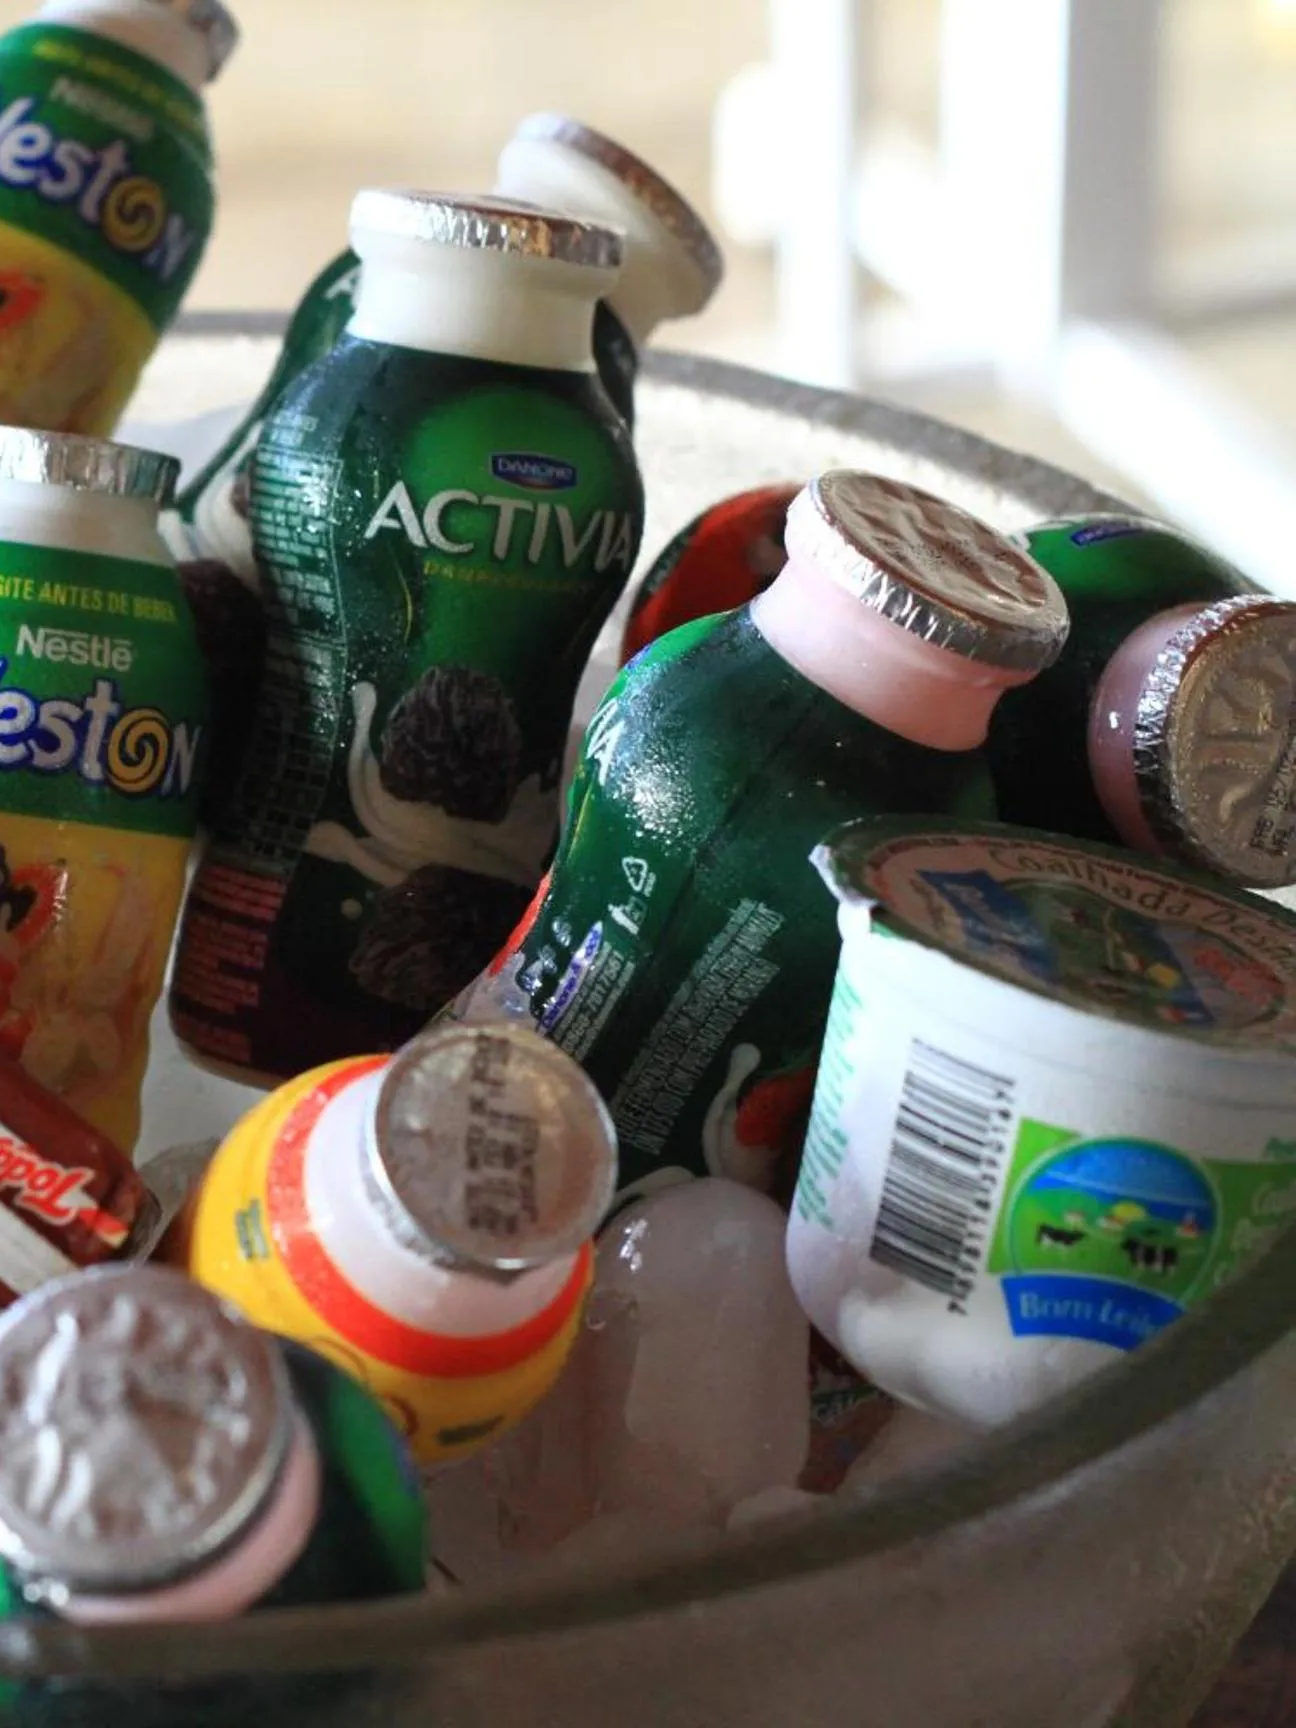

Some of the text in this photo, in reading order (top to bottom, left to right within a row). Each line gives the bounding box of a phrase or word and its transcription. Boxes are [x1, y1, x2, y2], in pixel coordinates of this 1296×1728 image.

[364, 480, 635, 572] ACTIVIA
[39, 583, 102, 611] ANTES
[107, 592, 128, 613] DE
[15, 623, 133, 672] Nestlé
